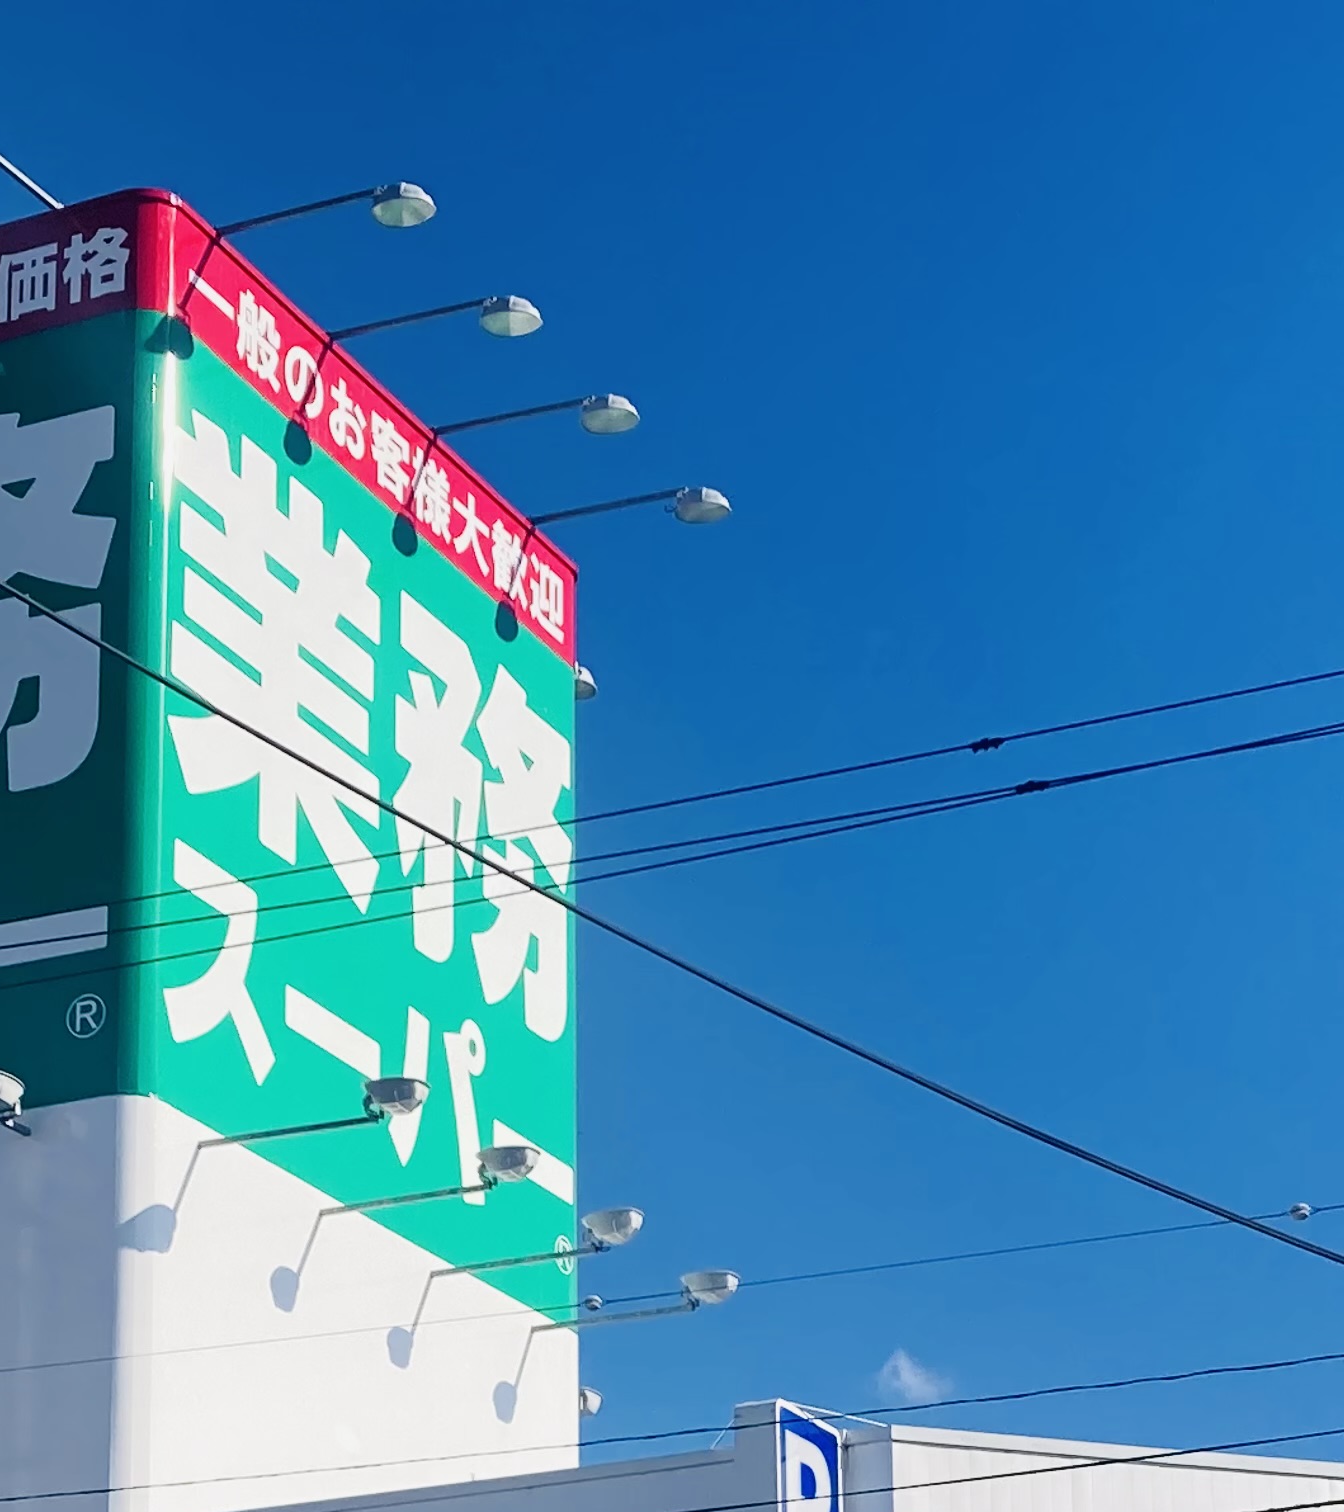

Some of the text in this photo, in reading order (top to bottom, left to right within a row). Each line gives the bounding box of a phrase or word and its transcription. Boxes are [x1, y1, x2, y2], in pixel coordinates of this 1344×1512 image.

[188, 268, 566, 645] 一般のお客様大歓迎
[168, 409, 573, 1042] 業務
[162, 837, 574, 1206] スーパー
